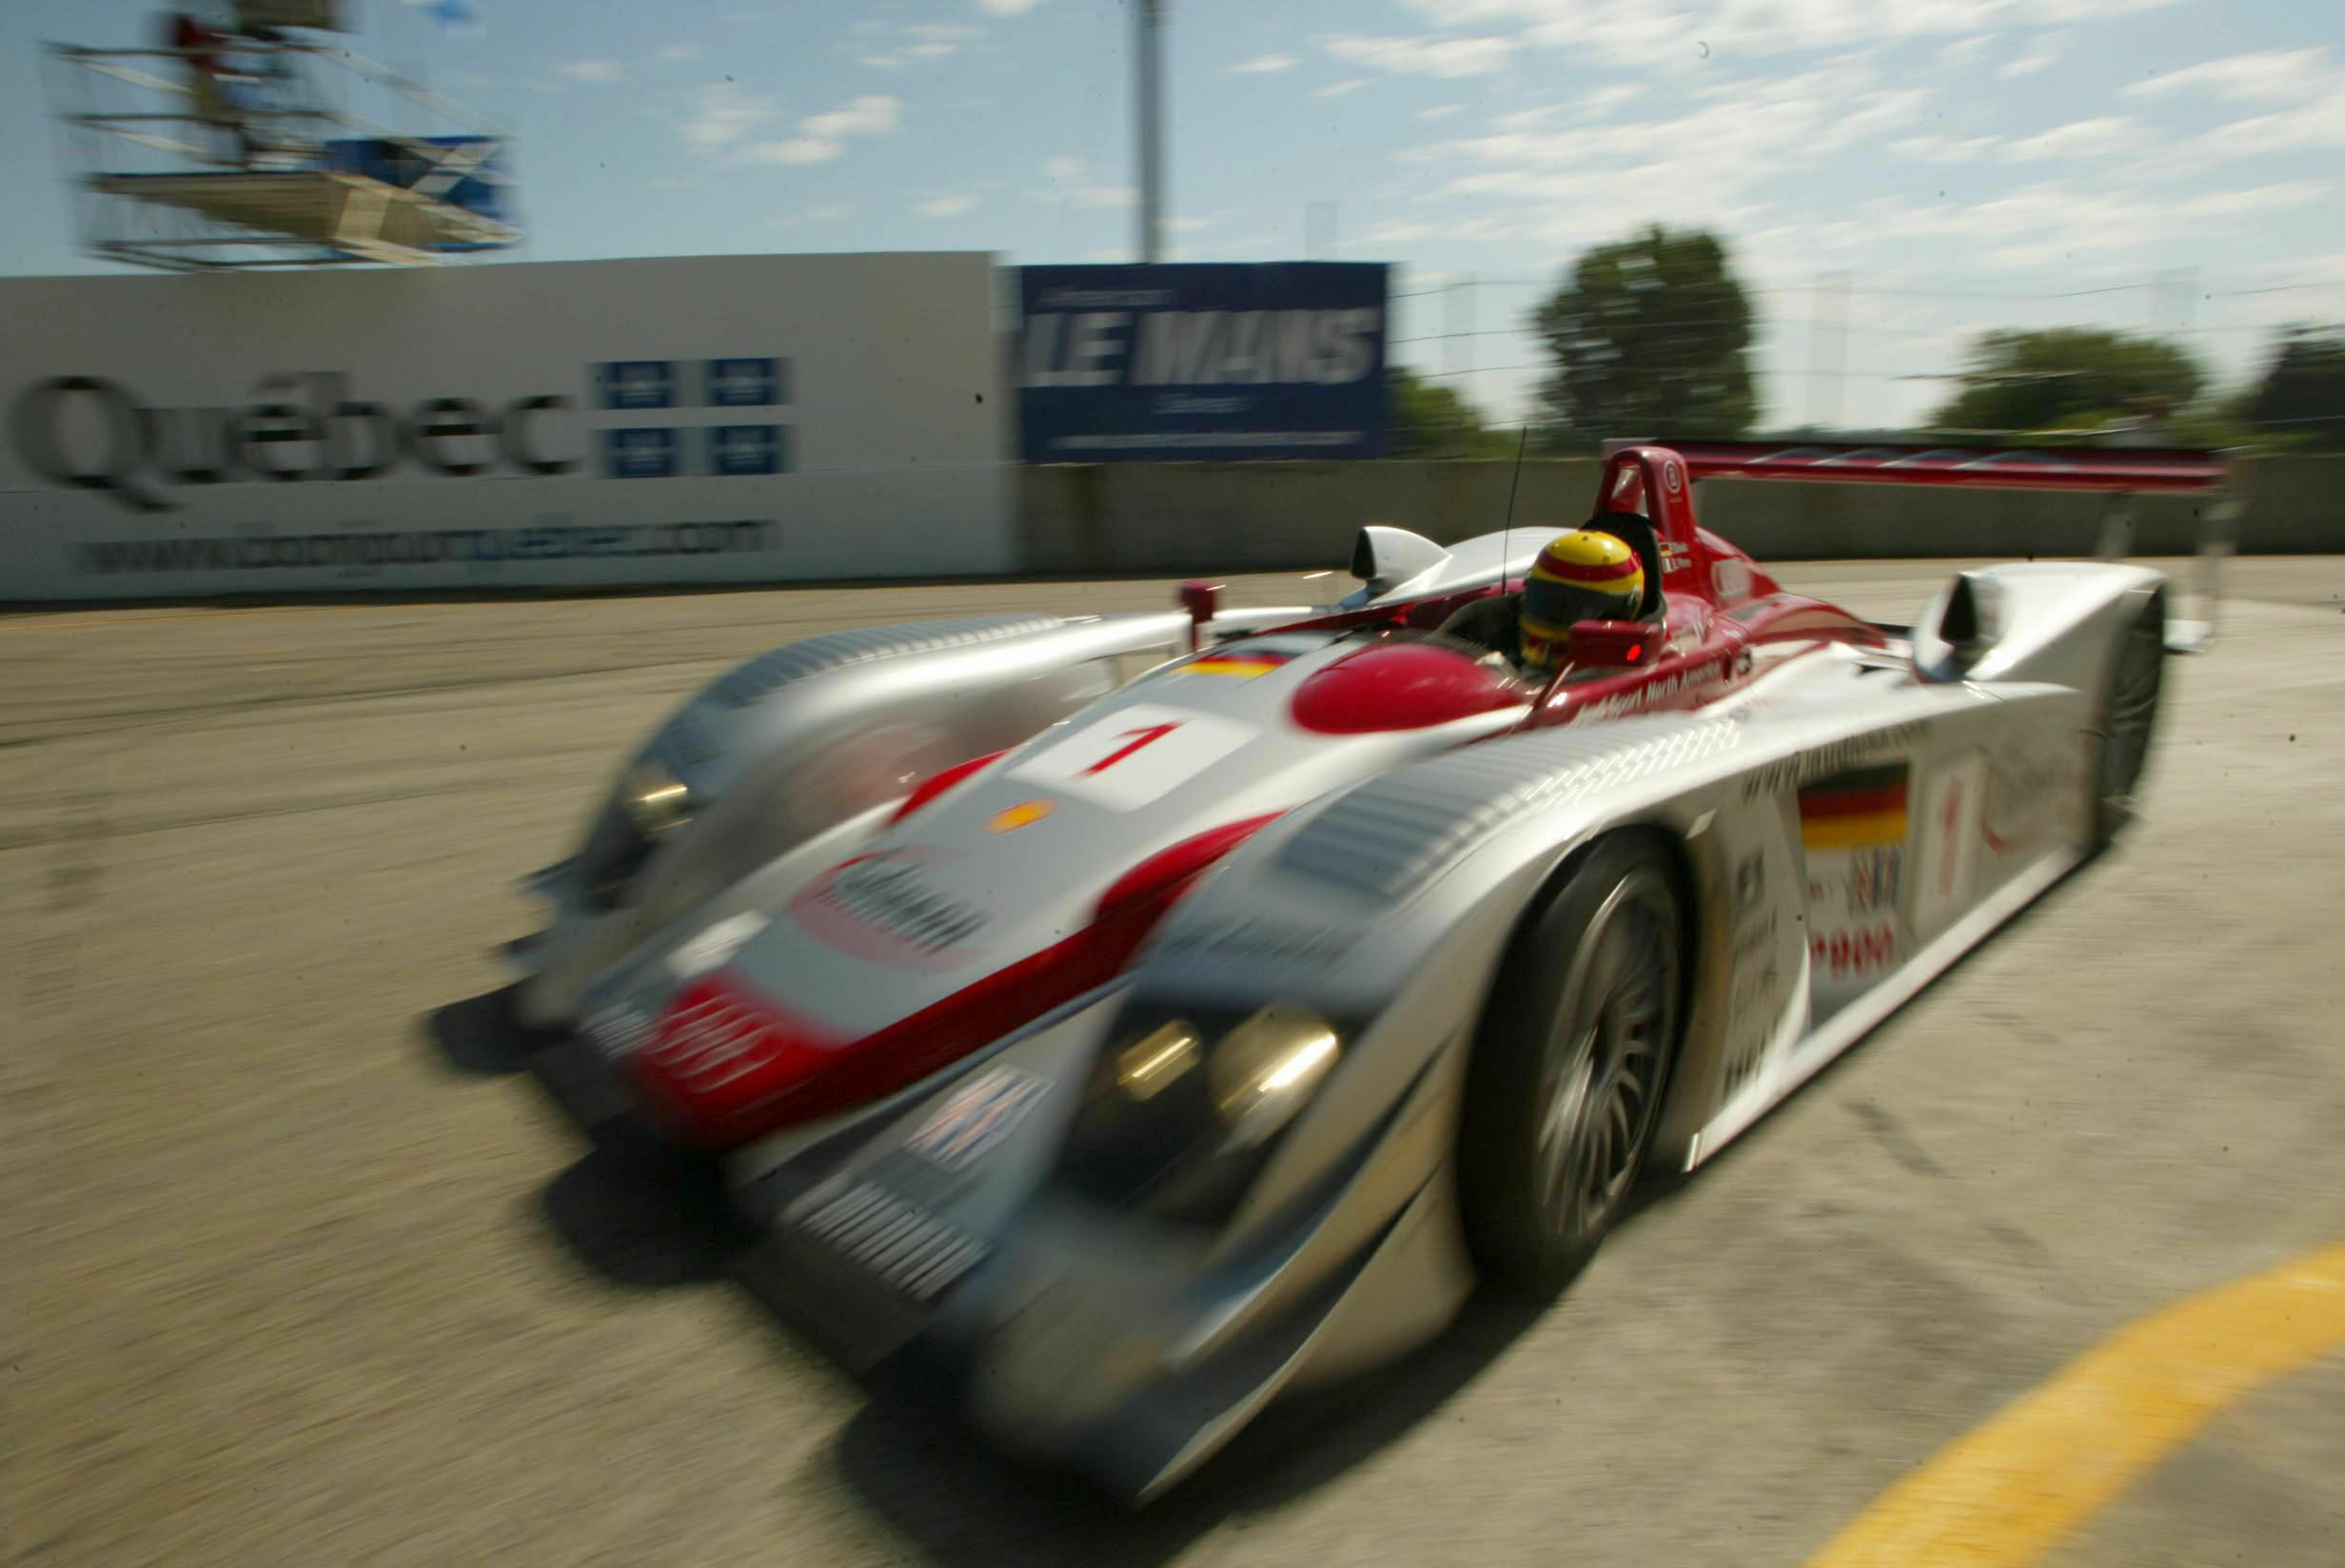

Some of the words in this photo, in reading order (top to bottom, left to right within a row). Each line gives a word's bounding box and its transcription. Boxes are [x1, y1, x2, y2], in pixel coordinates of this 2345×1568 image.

[1022, 311, 1135, 387] LE
[1131, 306, 1386, 385] MANS
[11, 370, 582, 512] Québec
[1646, 673, 1678, 703] North
[1077, 718, 1188, 780] 1
